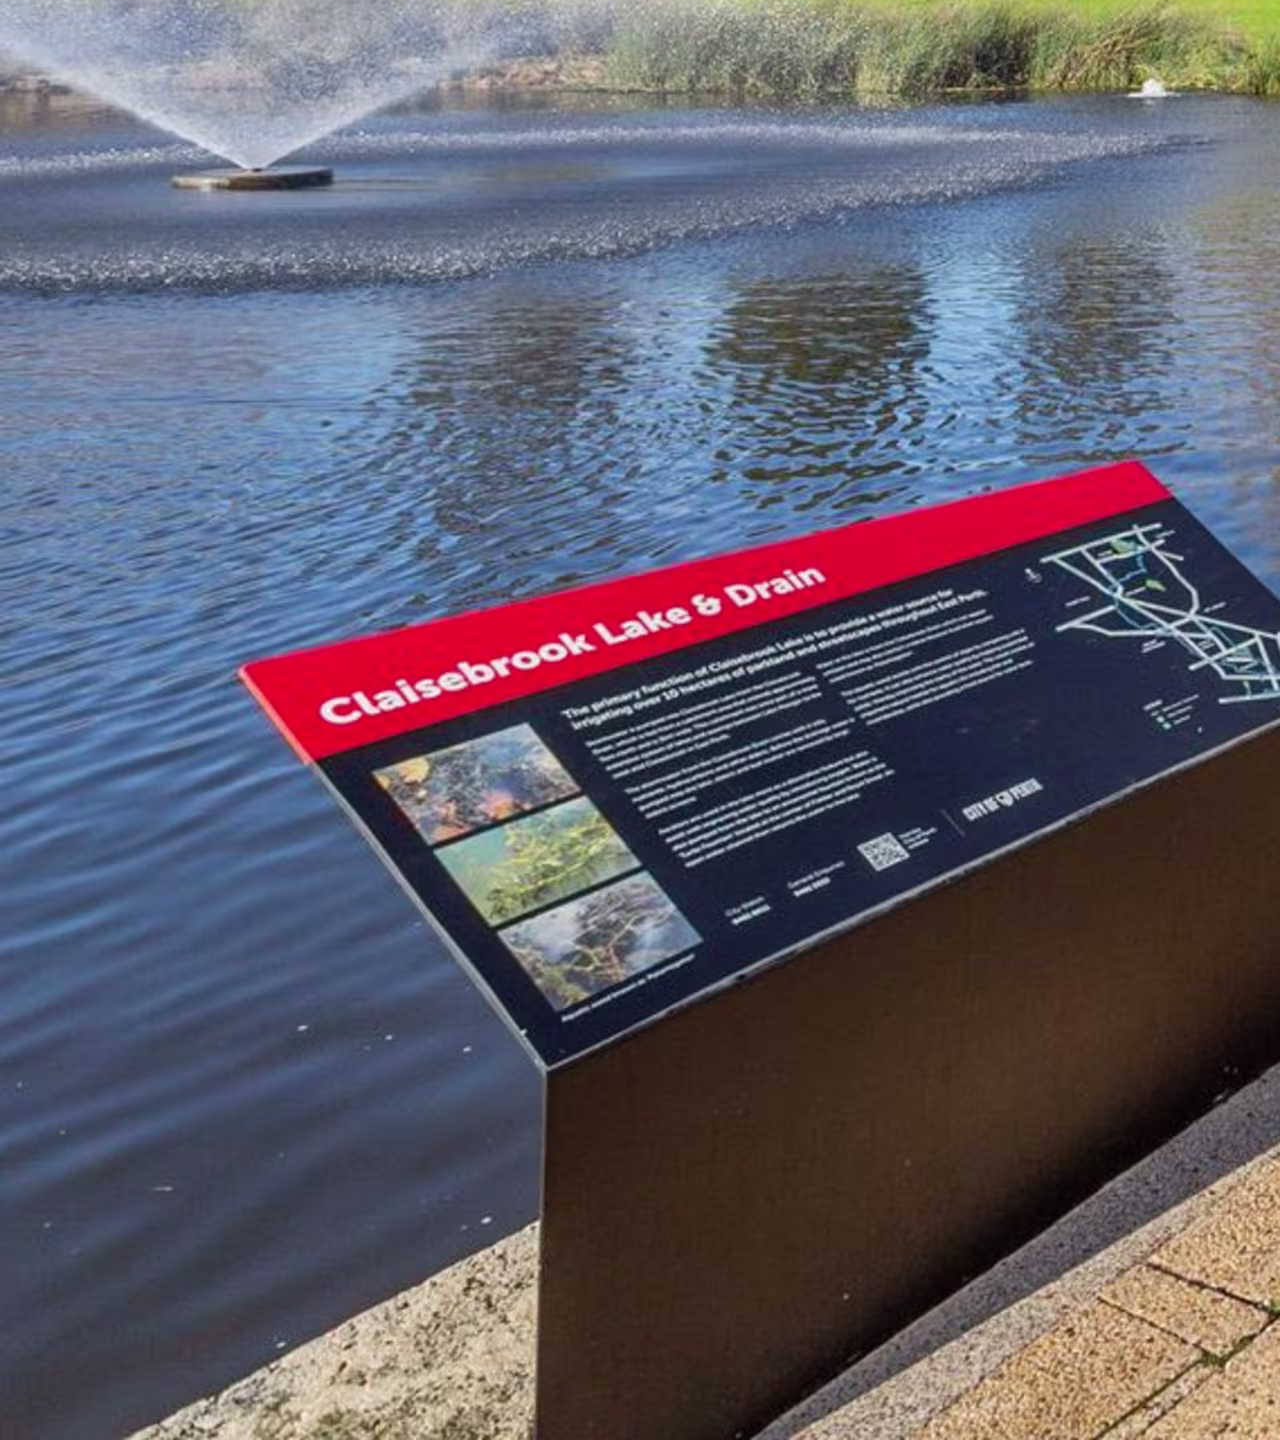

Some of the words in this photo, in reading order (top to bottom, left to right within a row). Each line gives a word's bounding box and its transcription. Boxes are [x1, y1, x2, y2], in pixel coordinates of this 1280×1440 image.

[320, 633, 595, 724] Claisebrook
[593, 607, 691, 645] Lake
[691, 594, 721, 616] &
[724, 568, 825, 607] Drain
